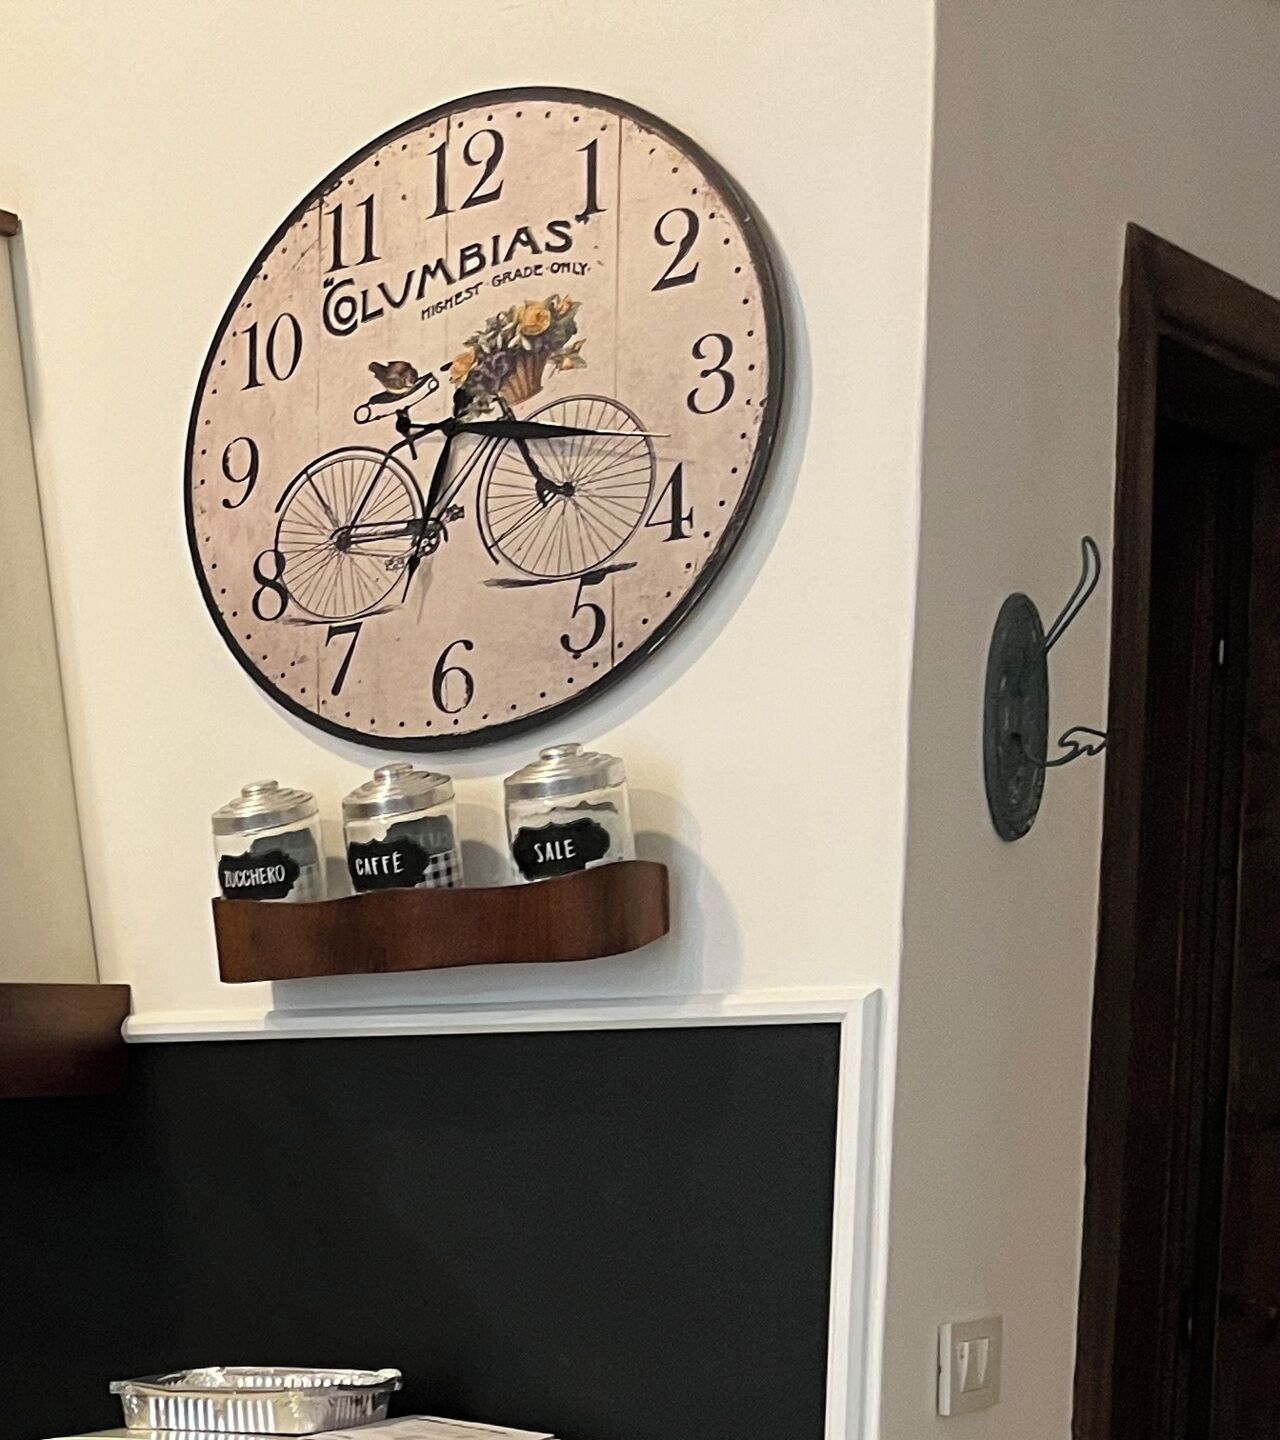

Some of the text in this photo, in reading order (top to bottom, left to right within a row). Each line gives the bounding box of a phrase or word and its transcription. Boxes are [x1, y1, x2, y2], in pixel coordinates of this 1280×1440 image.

[426, 128, 505, 220] 12
[576, 137, 608, 221] 1
[324, 193, 382, 273] 11
[651, 207, 701, 292] 2
[492, 264, 543, 287] GRADE
[241, 312, 303, 390] 10
[687, 333, 735, 415] 3
[221, 437, 260, 509] 9
[644, 463, 695, 542] 4
[252, 550, 288, 621] 8
[560, 572, 610, 654] 5
[325, 622, 363, 696] 7
[432, 639, 474, 714] 6
[224, 864, 286, 888] ZUCCHERO
[534, 839, 576, 863] SALE
